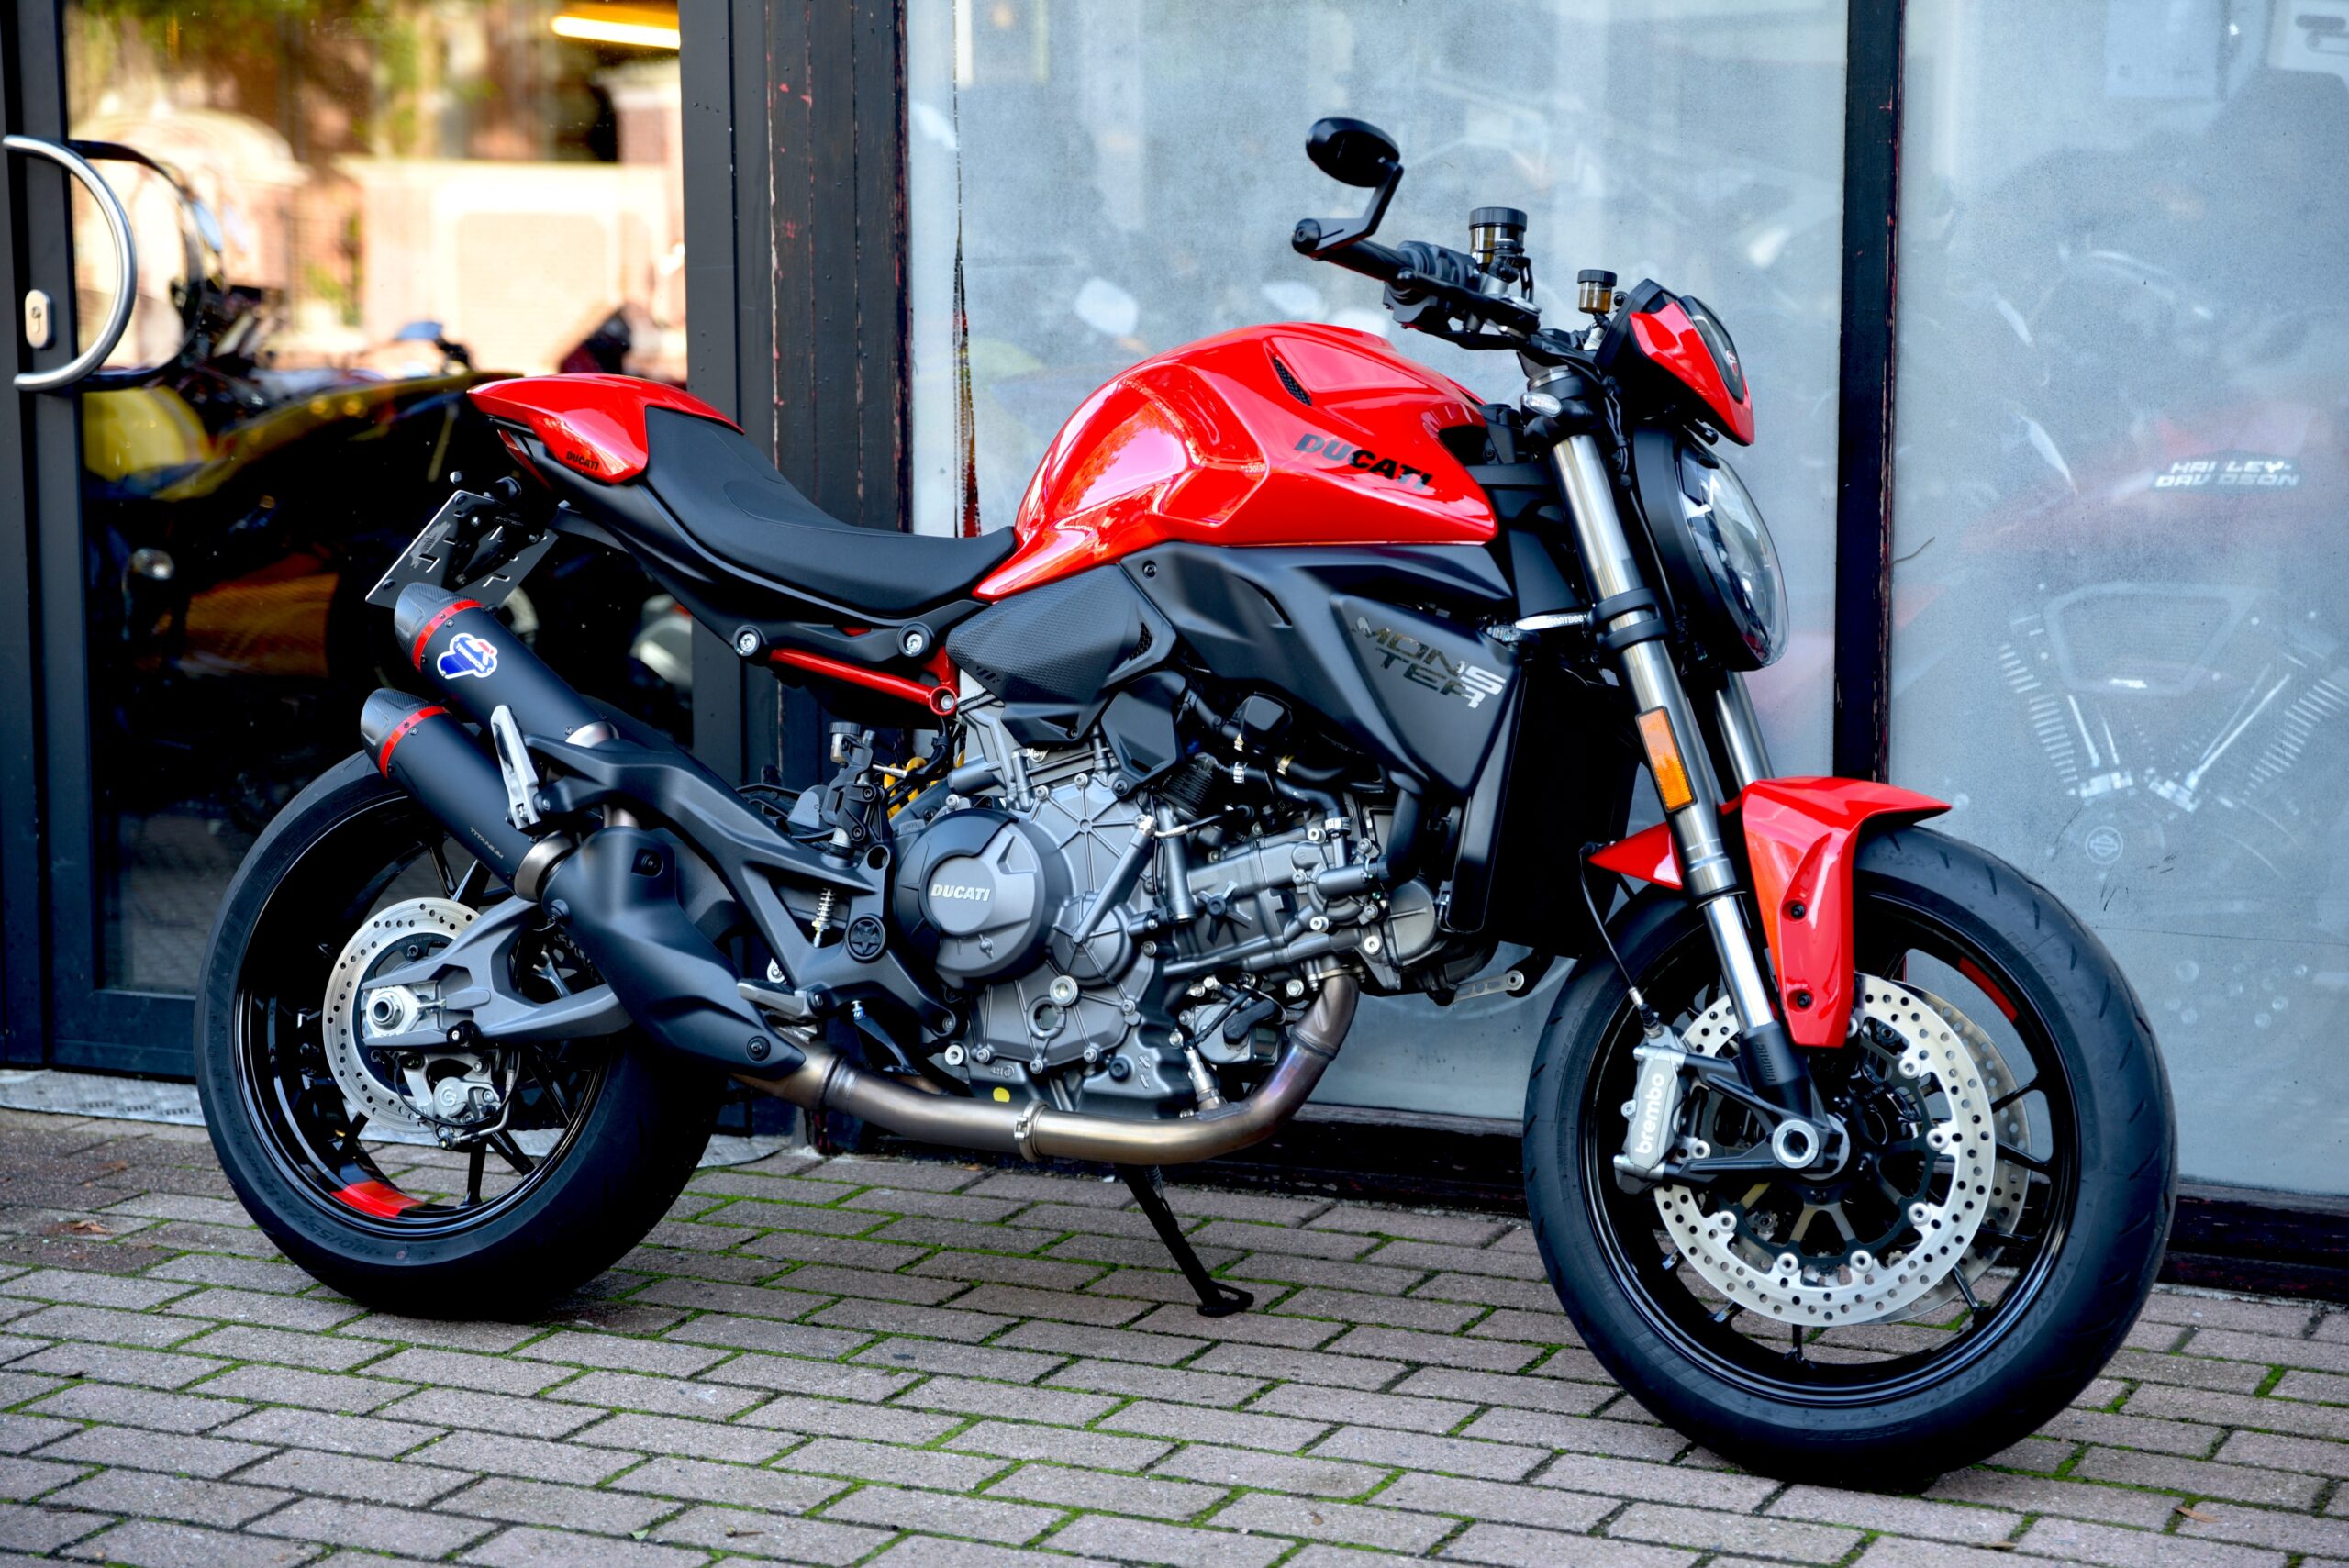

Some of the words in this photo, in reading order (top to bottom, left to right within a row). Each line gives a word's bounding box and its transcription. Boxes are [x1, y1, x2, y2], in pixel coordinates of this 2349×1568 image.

[565, 450, 600, 471] DUCATI
[1294, 432, 1433, 491] DUCATI
[469, 826, 504, 860] TITANIUM
[930, 884, 991, 902] DUCATI
[1635, 1073, 1664, 1154] brembo
